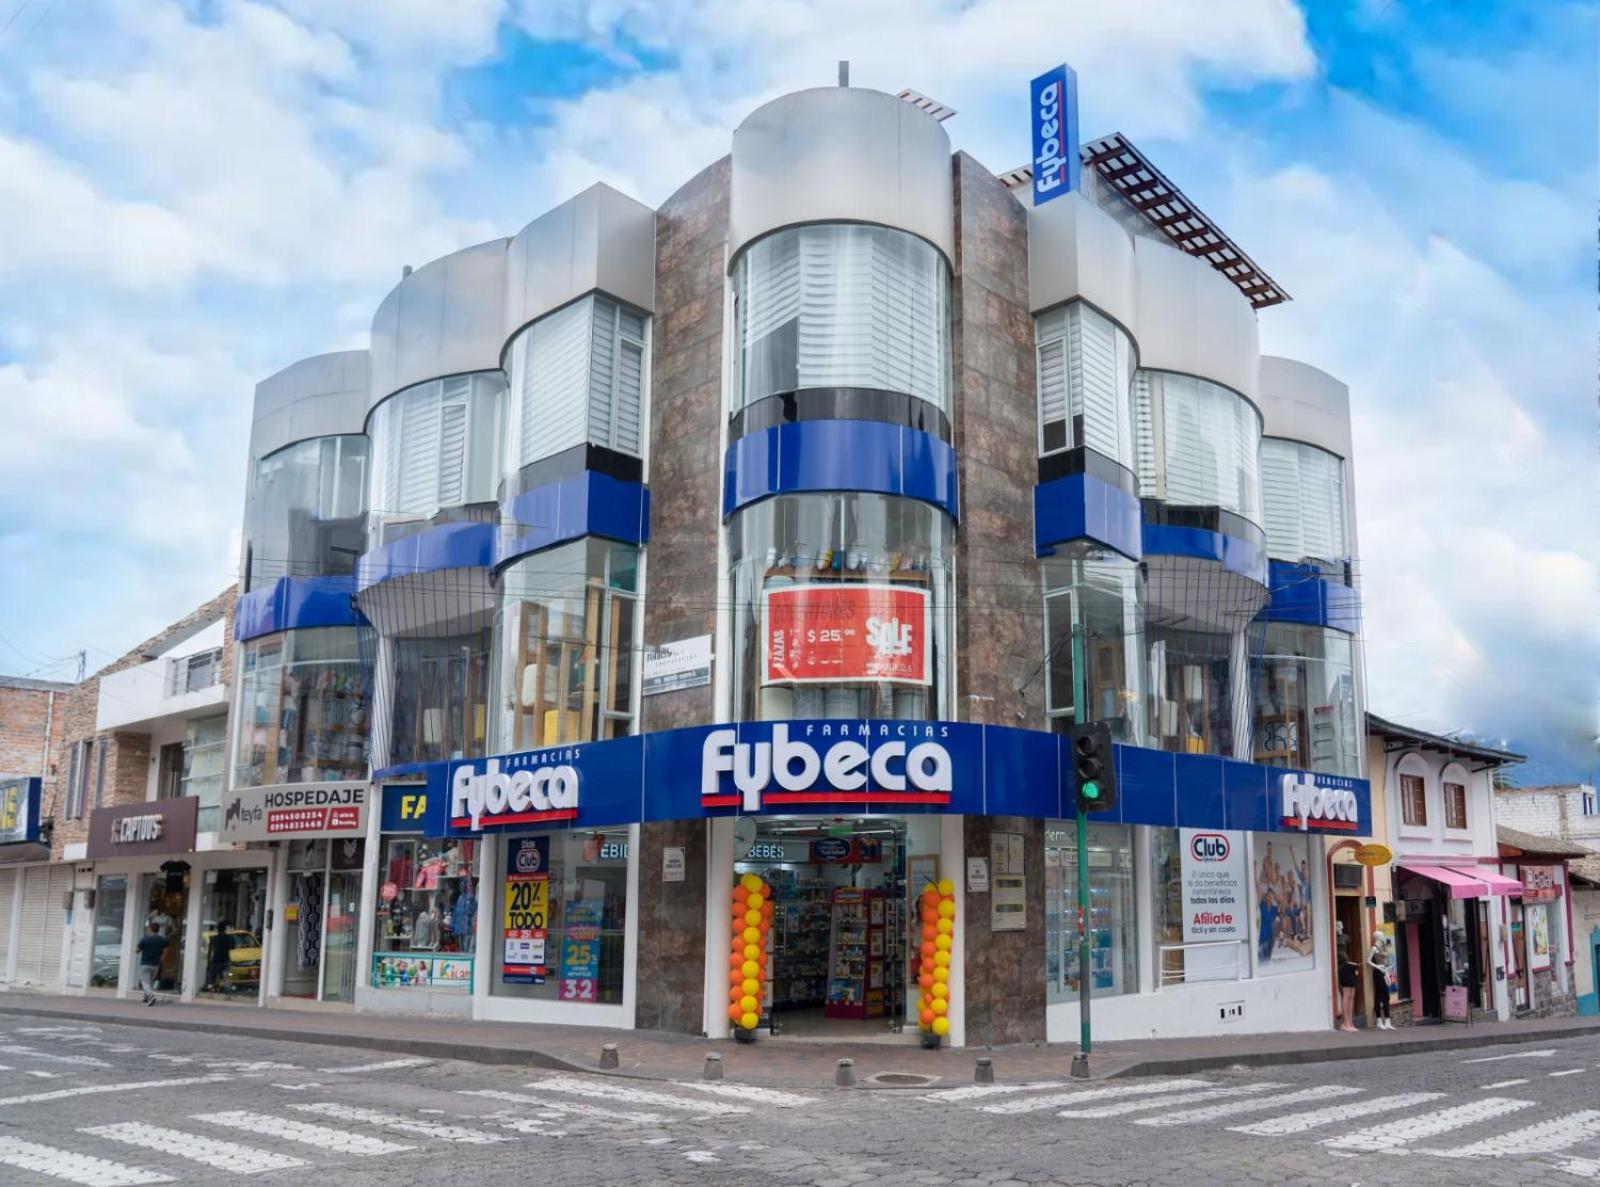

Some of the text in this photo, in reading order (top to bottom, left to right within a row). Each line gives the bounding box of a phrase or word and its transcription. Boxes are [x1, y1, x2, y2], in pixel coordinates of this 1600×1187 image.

[806, 725, 949, 738] FARMACIAS
[505, 748, 580, 768] FARMACIAS
[265, 788, 364, 808] HOSPEDAJE
[1194, 838, 1227, 857] Club
[509, 912, 544, 930] TODO
